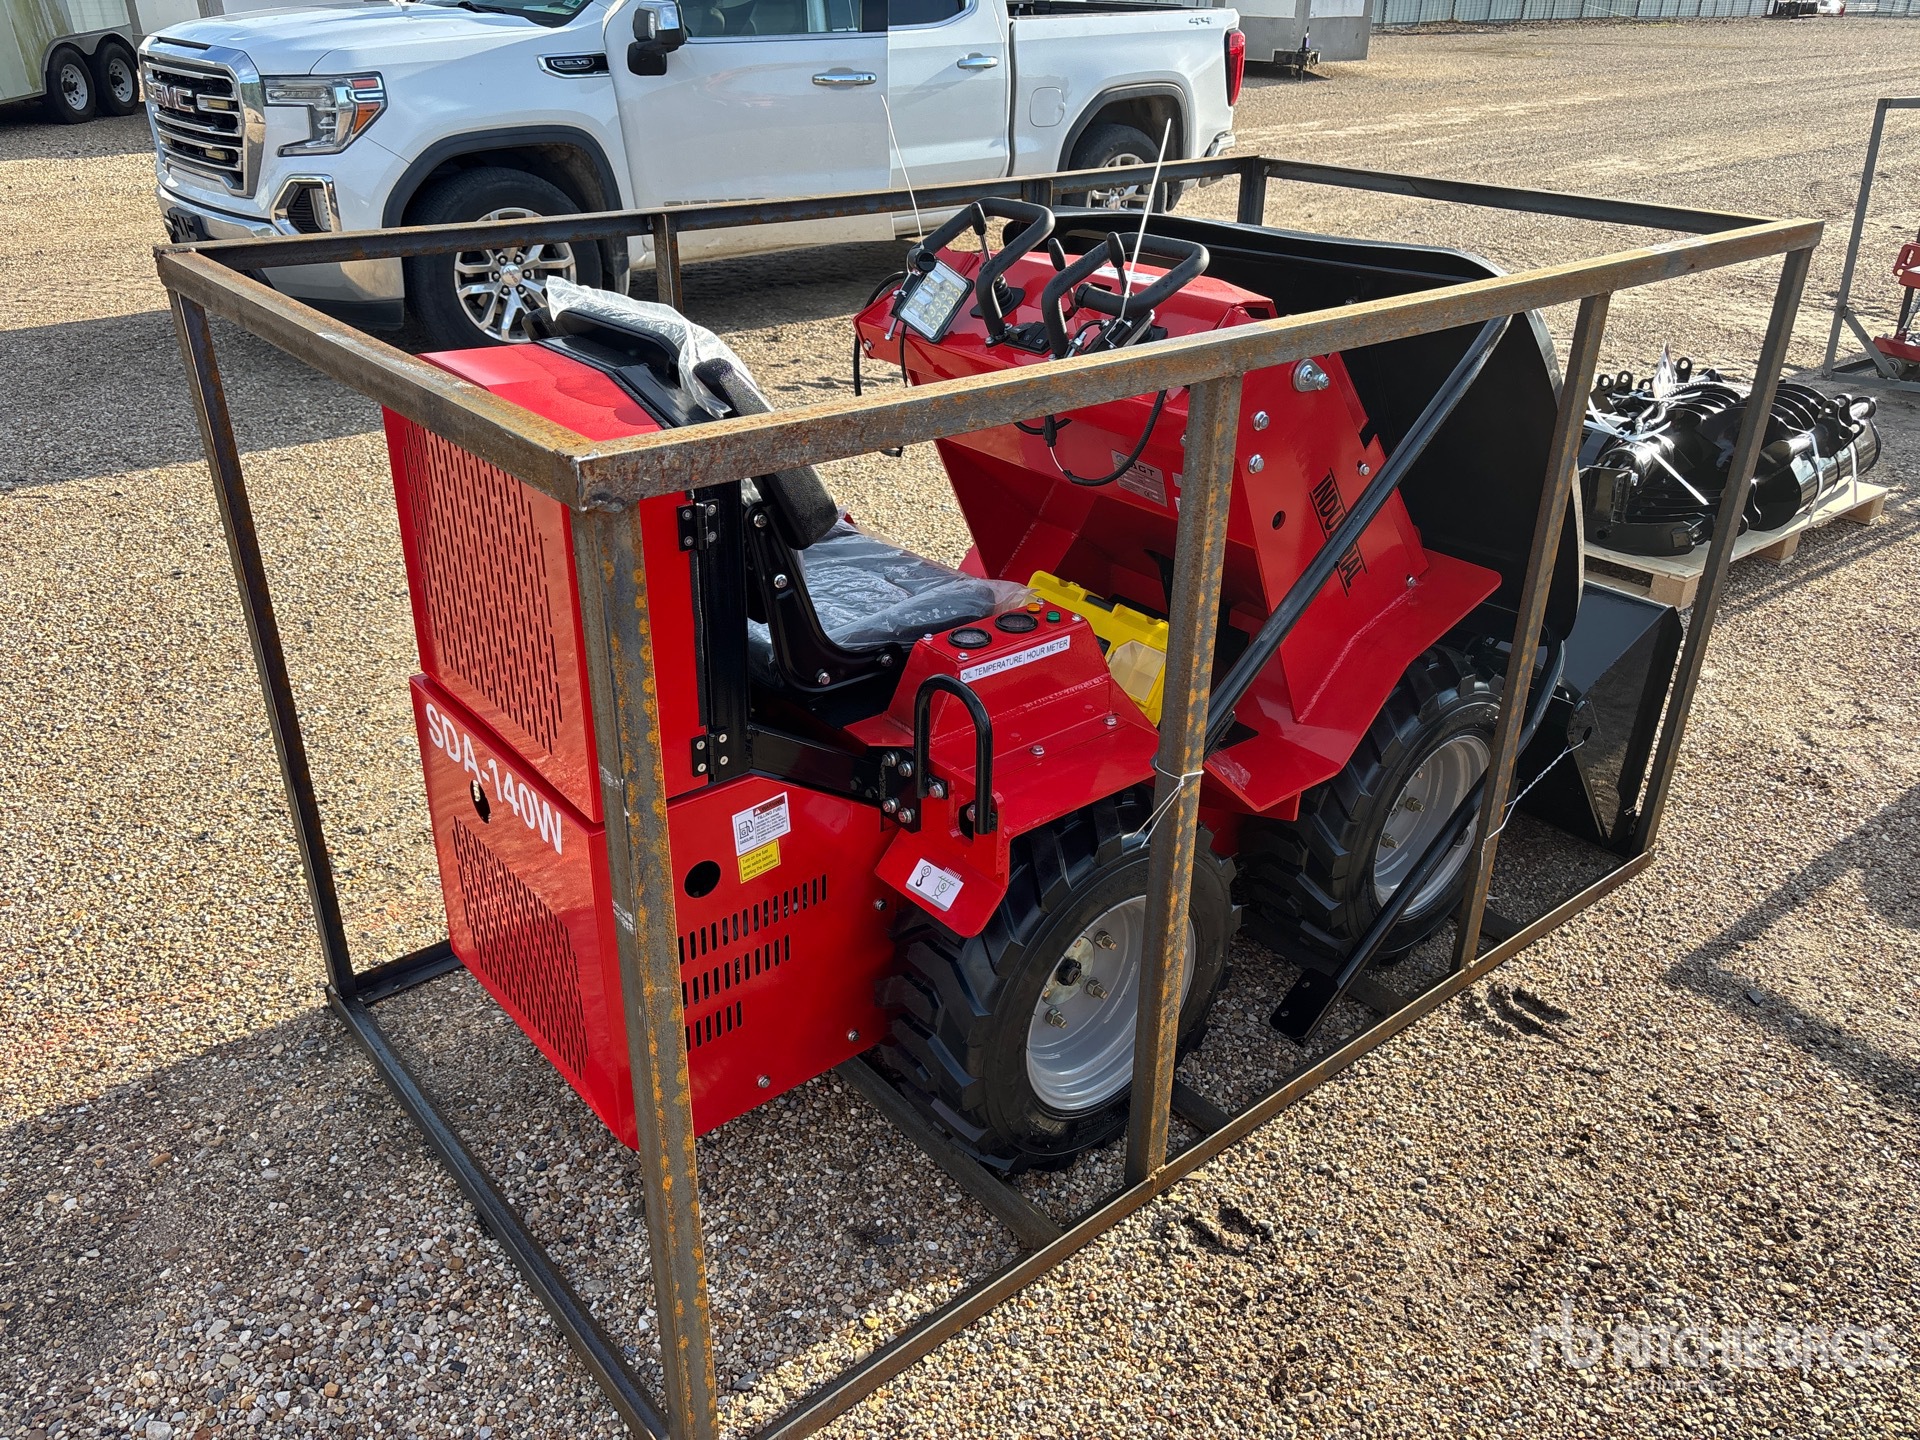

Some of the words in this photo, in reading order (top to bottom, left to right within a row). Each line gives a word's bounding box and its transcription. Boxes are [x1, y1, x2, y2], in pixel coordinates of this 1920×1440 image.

[146, 81, 195, 113] GMC
[1026, 647, 1045, 661] HOUR
[1046, 639, 1068, 653] METER
[961, 670, 973, 681] OIL
[974, 654, 1023, 677] TEMPERATURE
[425, 703, 563, 855] SDA-140W
[772, 806, 783, 815] FUEL
